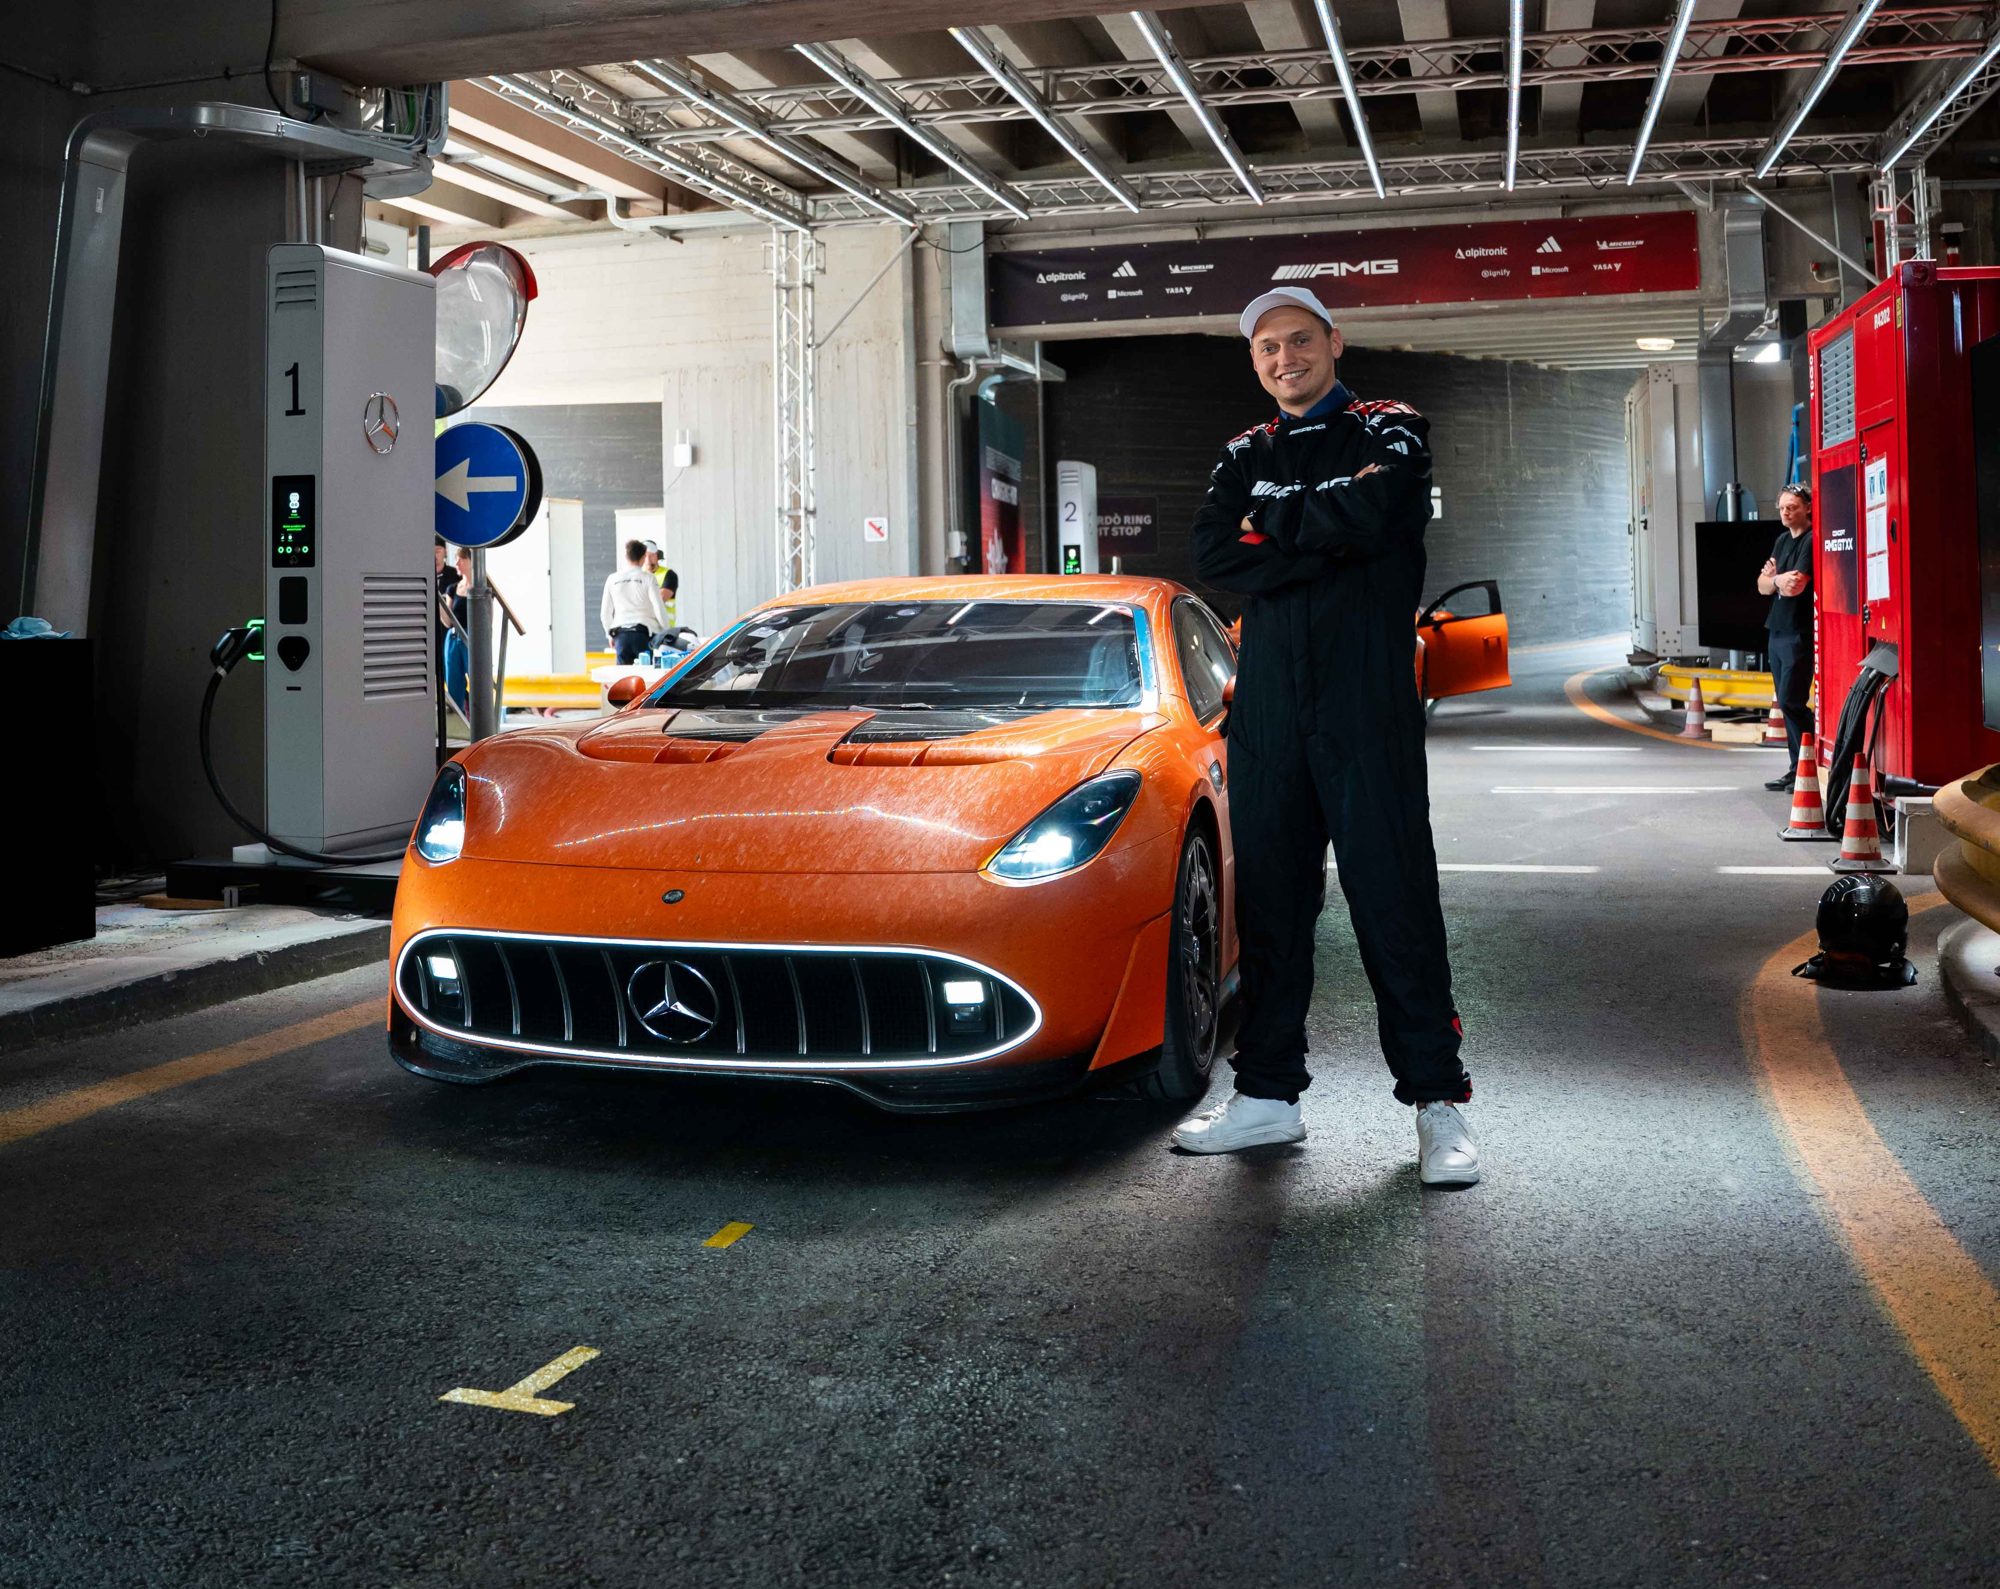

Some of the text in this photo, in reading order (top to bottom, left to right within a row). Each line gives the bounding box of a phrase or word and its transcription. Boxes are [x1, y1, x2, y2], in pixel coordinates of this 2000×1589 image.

[1465, 246, 1508, 258] alpitronic
[1309, 259, 1399, 278] AMG
[1592, 263, 1612, 271] YASA
[1046, 271, 1086, 283] alpitronic
[1117, 289, 1143, 297] Microsoft
[1165, 287, 1184, 295] YASA
[284, 362, 306, 417] 1
[1064, 502, 1078, 522] 2
[1123, 515, 1152, 525] RING
[1111, 526, 1142, 537] STOP
